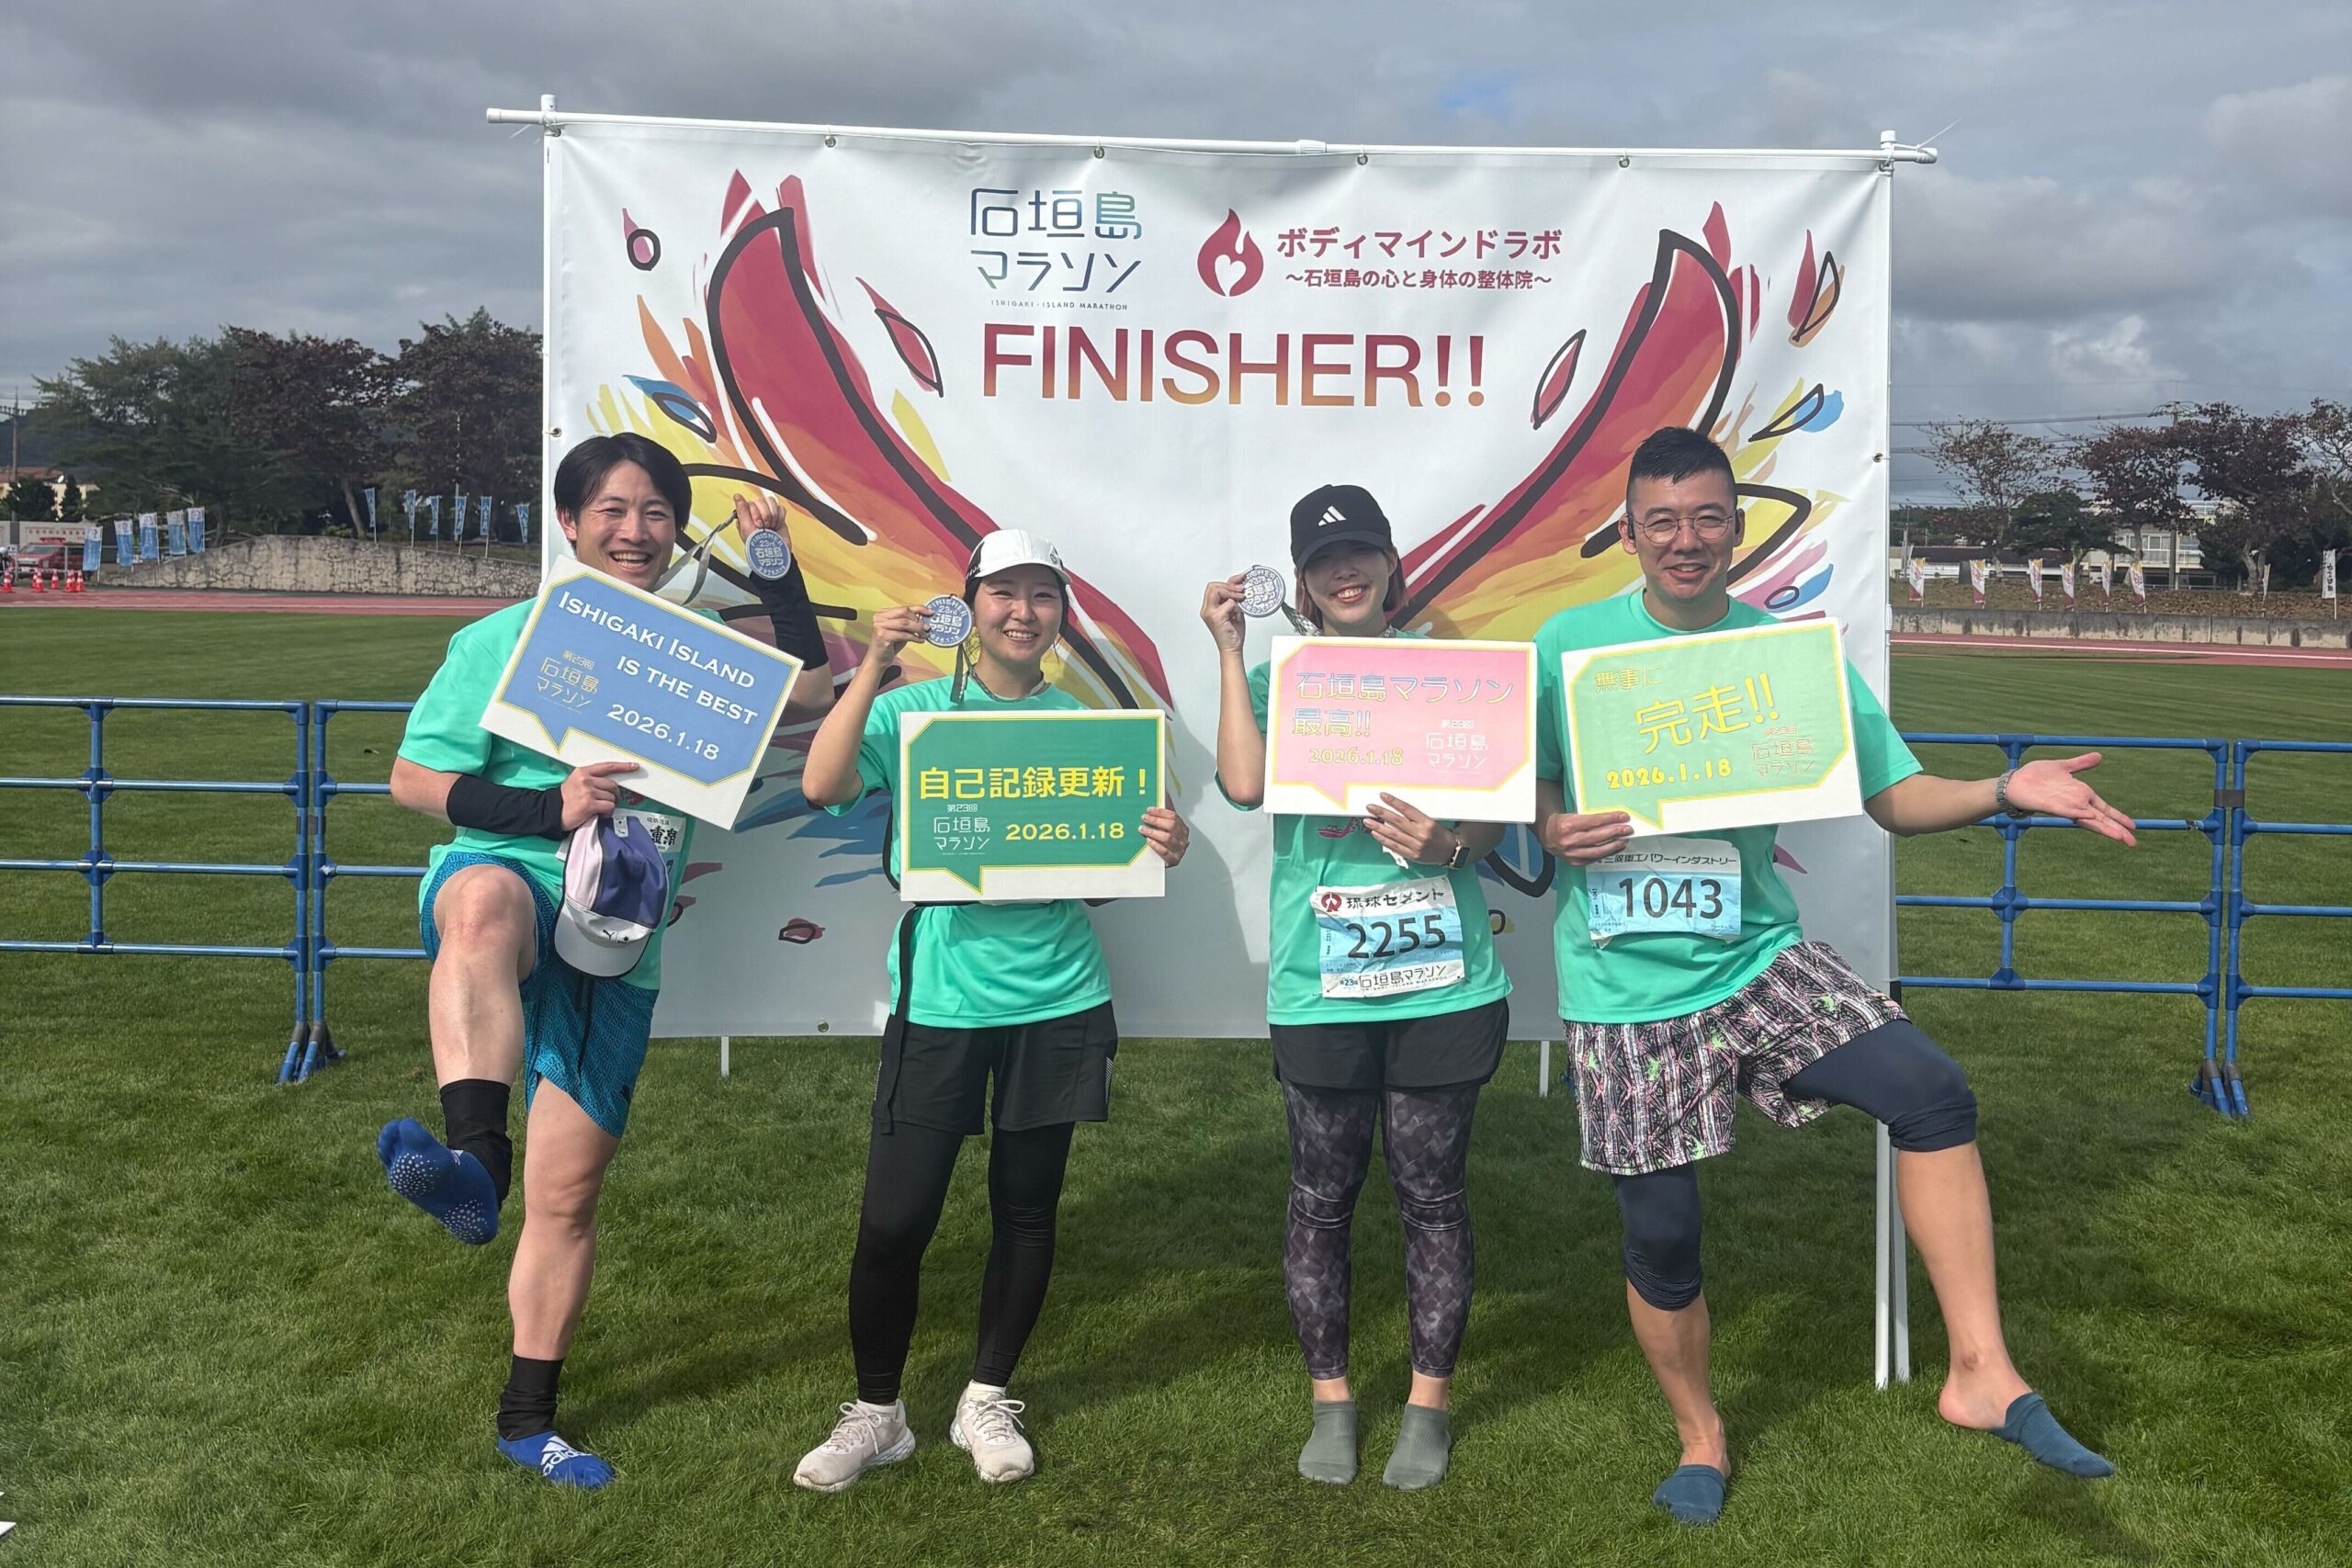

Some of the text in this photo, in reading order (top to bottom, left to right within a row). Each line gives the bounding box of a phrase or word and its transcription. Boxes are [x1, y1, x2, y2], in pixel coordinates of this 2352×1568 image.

[970, 187, 1142, 240] 石垣島
[1277, 227, 1563, 259] ボディマインドラボ
[970, 249, 1142, 294] マラソン
[1080, 302, 1128, 310] MARATHON
[982, 322, 1485, 408] FINISHER!!
[559, 592, 755, 689] ISHIGAKI ISLAND
[537, 675, 592, 707] マラソン
[540, 657, 598, 694] 石垣島
[616, 655, 759, 725] IS THE BEST
[1296, 672, 1513, 705] 石垣島マラソン
[606, 704, 719, 761] 2026.1.18
[1426, 732, 1489, 750] 石垣島
[1309, 747, 1404, 765] 2026.1.18
[1426, 752, 1488, 769] マラソン
[1606, 758, 1732, 789] 2026.1.18
[933, 817, 990, 833] 石垣島
[1005, 822, 1125, 840] 2026.1.18
[933, 836, 990, 851] マラソン
[1347, 887, 1444, 908] 琉球セメント
[1619, 877, 1723, 919] 1043
[1346, 914, 1446, 958] 2255
[1360, 965, 1446, 988] 石垣島マラソン
